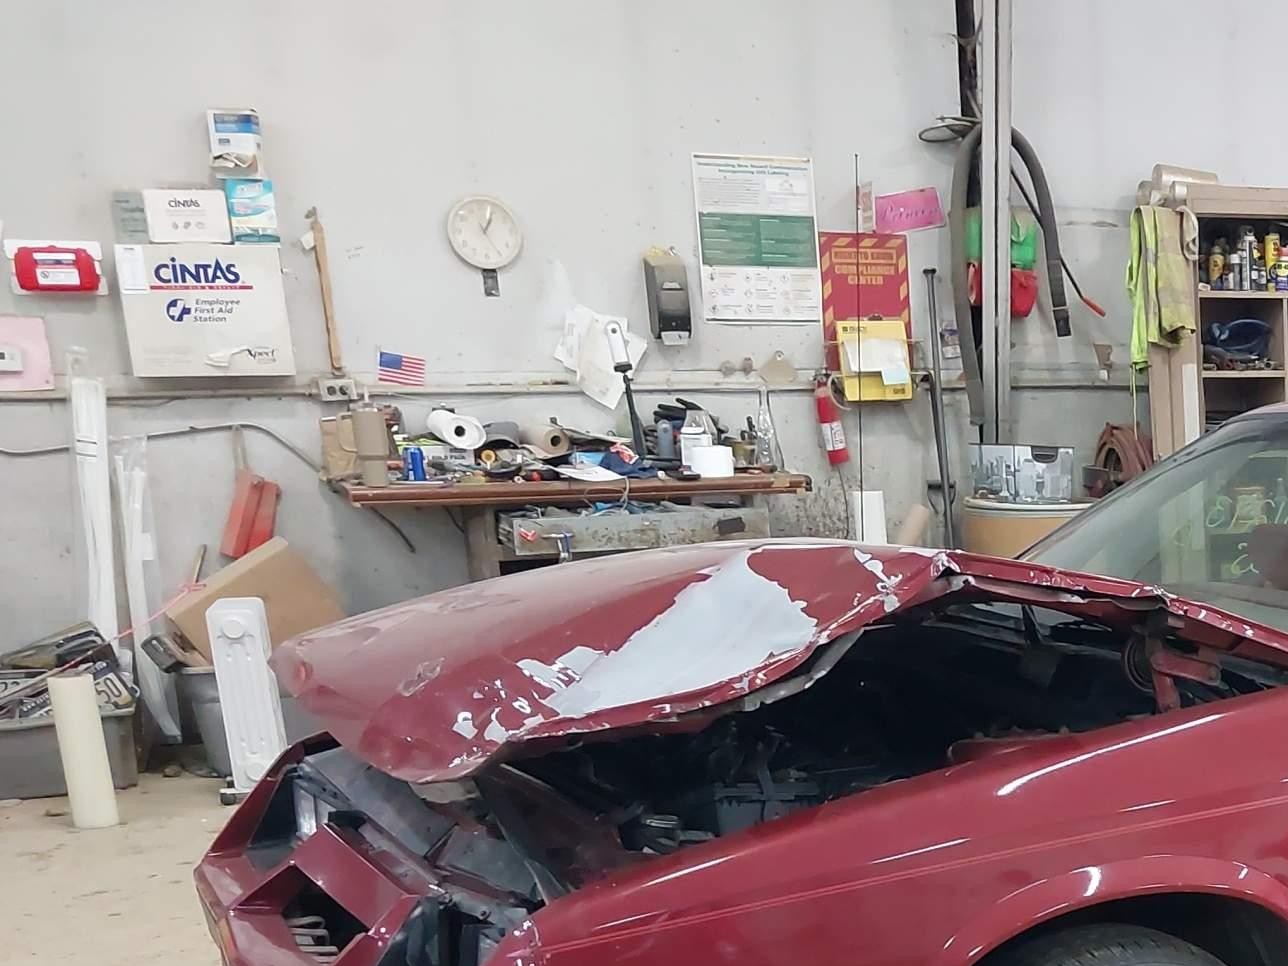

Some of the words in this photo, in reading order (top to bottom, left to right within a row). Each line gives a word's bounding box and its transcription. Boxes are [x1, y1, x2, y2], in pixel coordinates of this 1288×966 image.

[195, 298, 241, 306] Employee
[194, 306, 215, 314] First
[217, 306, 234, 314] Aid
